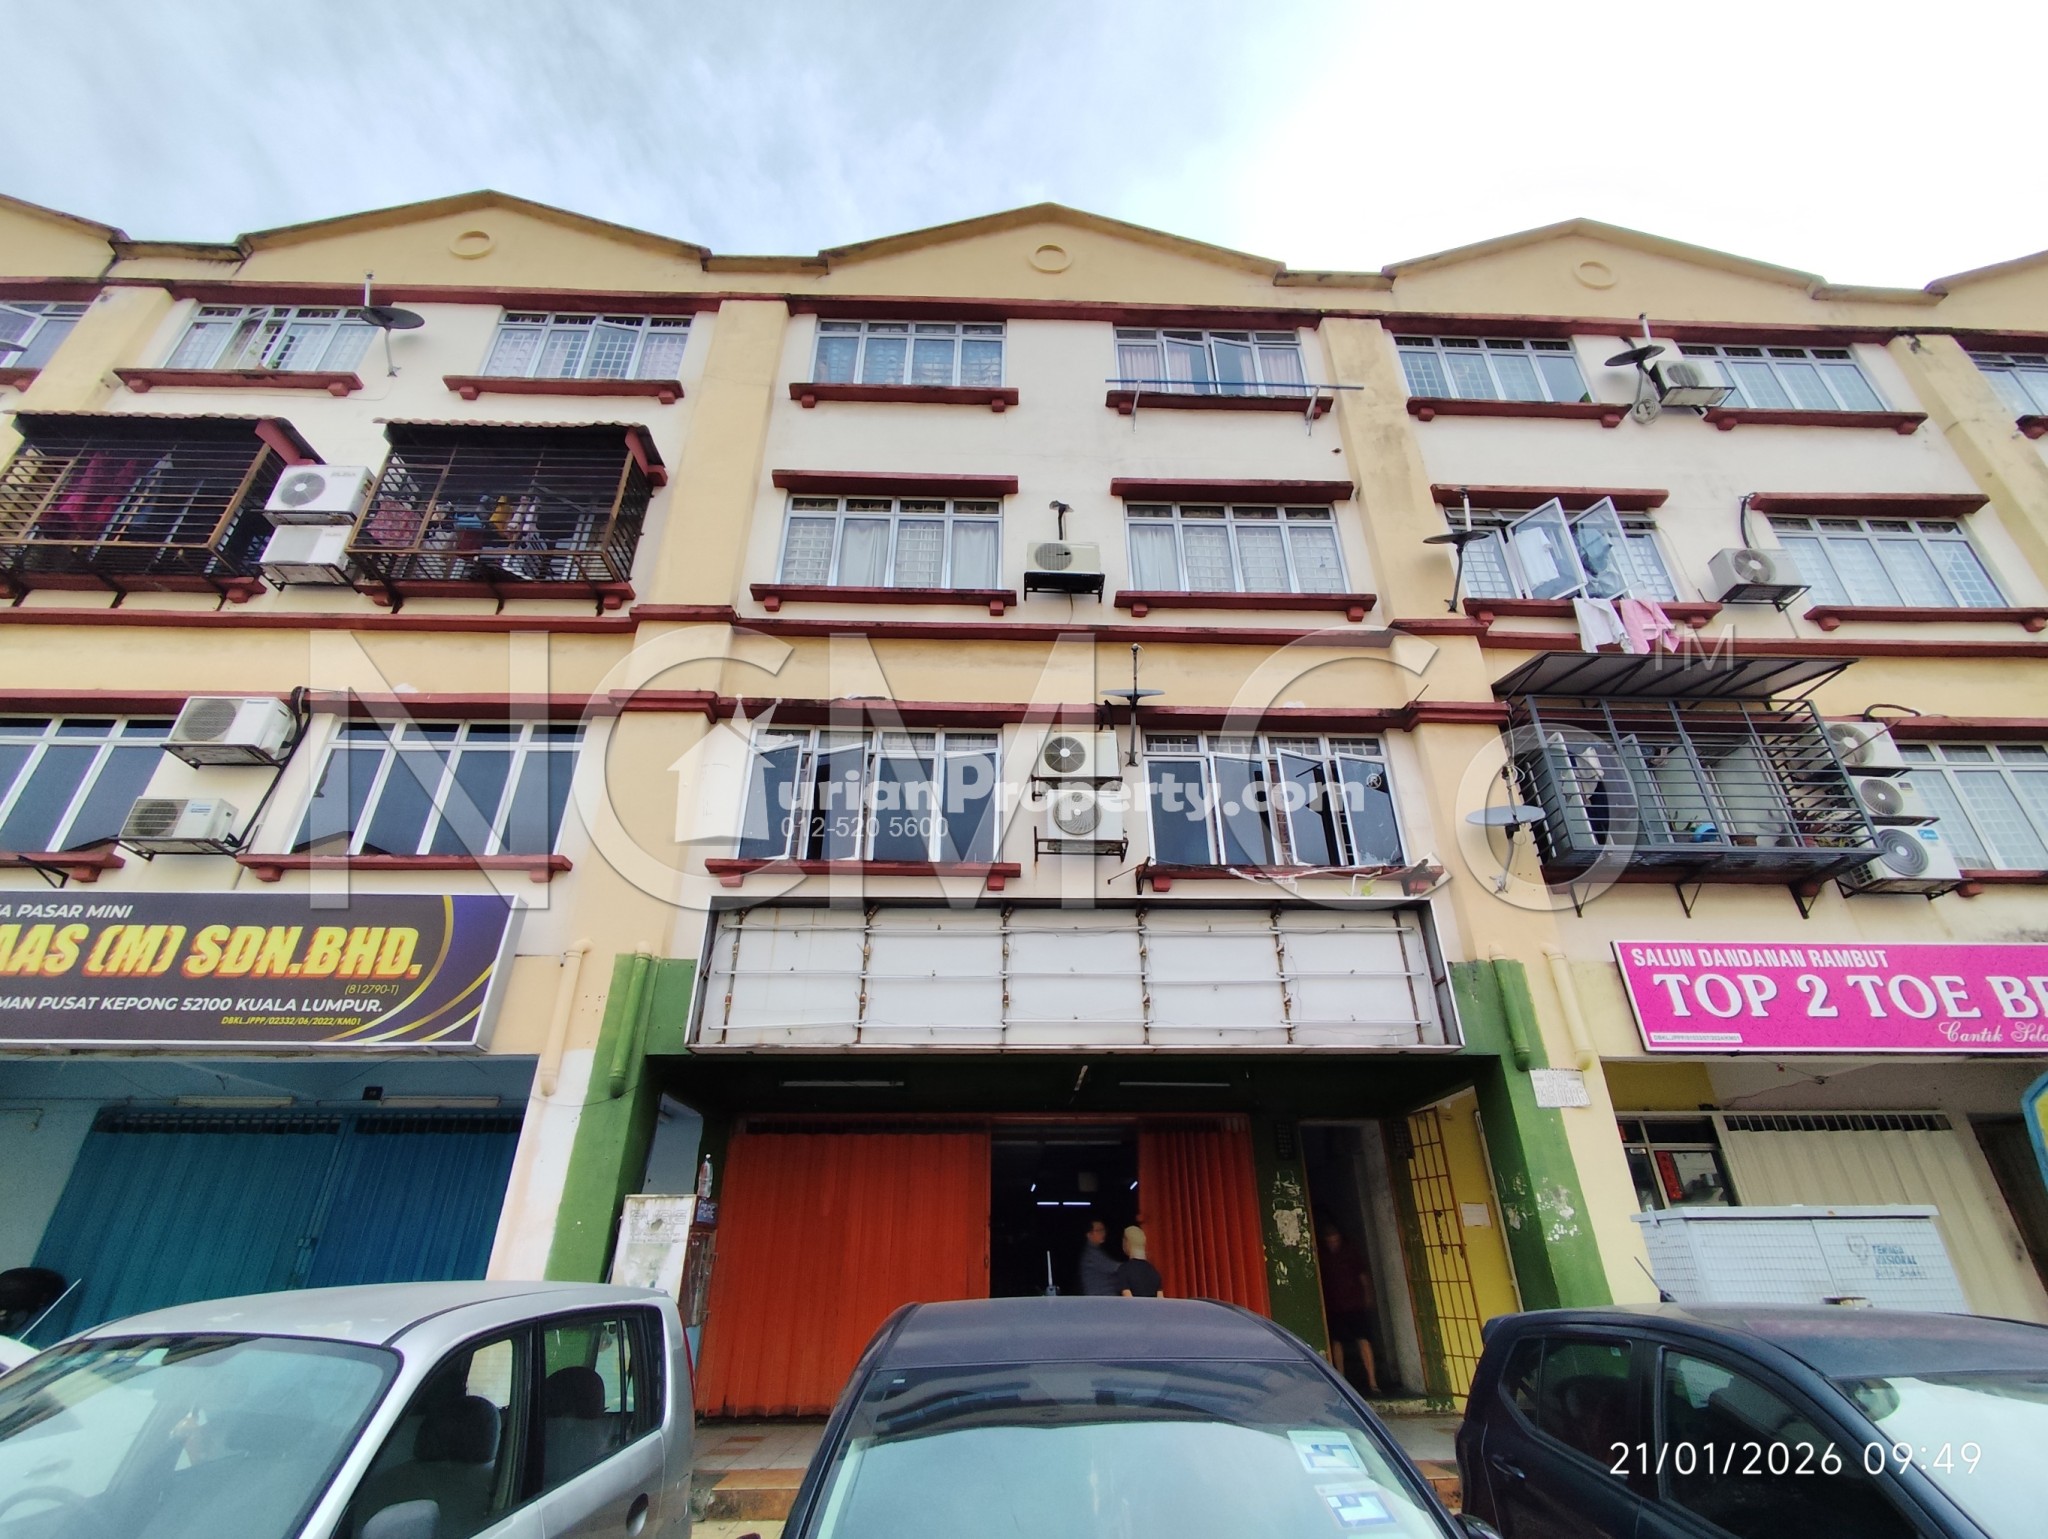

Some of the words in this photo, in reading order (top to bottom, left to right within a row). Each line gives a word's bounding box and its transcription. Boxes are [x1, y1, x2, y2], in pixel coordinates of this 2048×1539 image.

[16, 904, 81, 919] PASAR
[86, 904, 133, 919] MINI
[1631, 948, 1696, 967] SALUN
[1698, 949, 1807, 968] DANDANAN
[1808, 949, 1889, 968] RAMBUT
[344, 984, 399, 996] (812790-T)
[1653, 973, 1778, 1019] TOP
[1797, 974, 1839, 1018] 2
[1846, 974, 1982, 1019] TOE
[35, 996, 99, 1011] PUSAT
[101, 997, 178, 1012] KEPONG
[180, 998, 232, 1012] 52100
[235, 998, 297, 1012] KUALA
[301, 998, 383, 1013] LUMPUR.
[1938, 1021, 2003, 1043] Cantik
